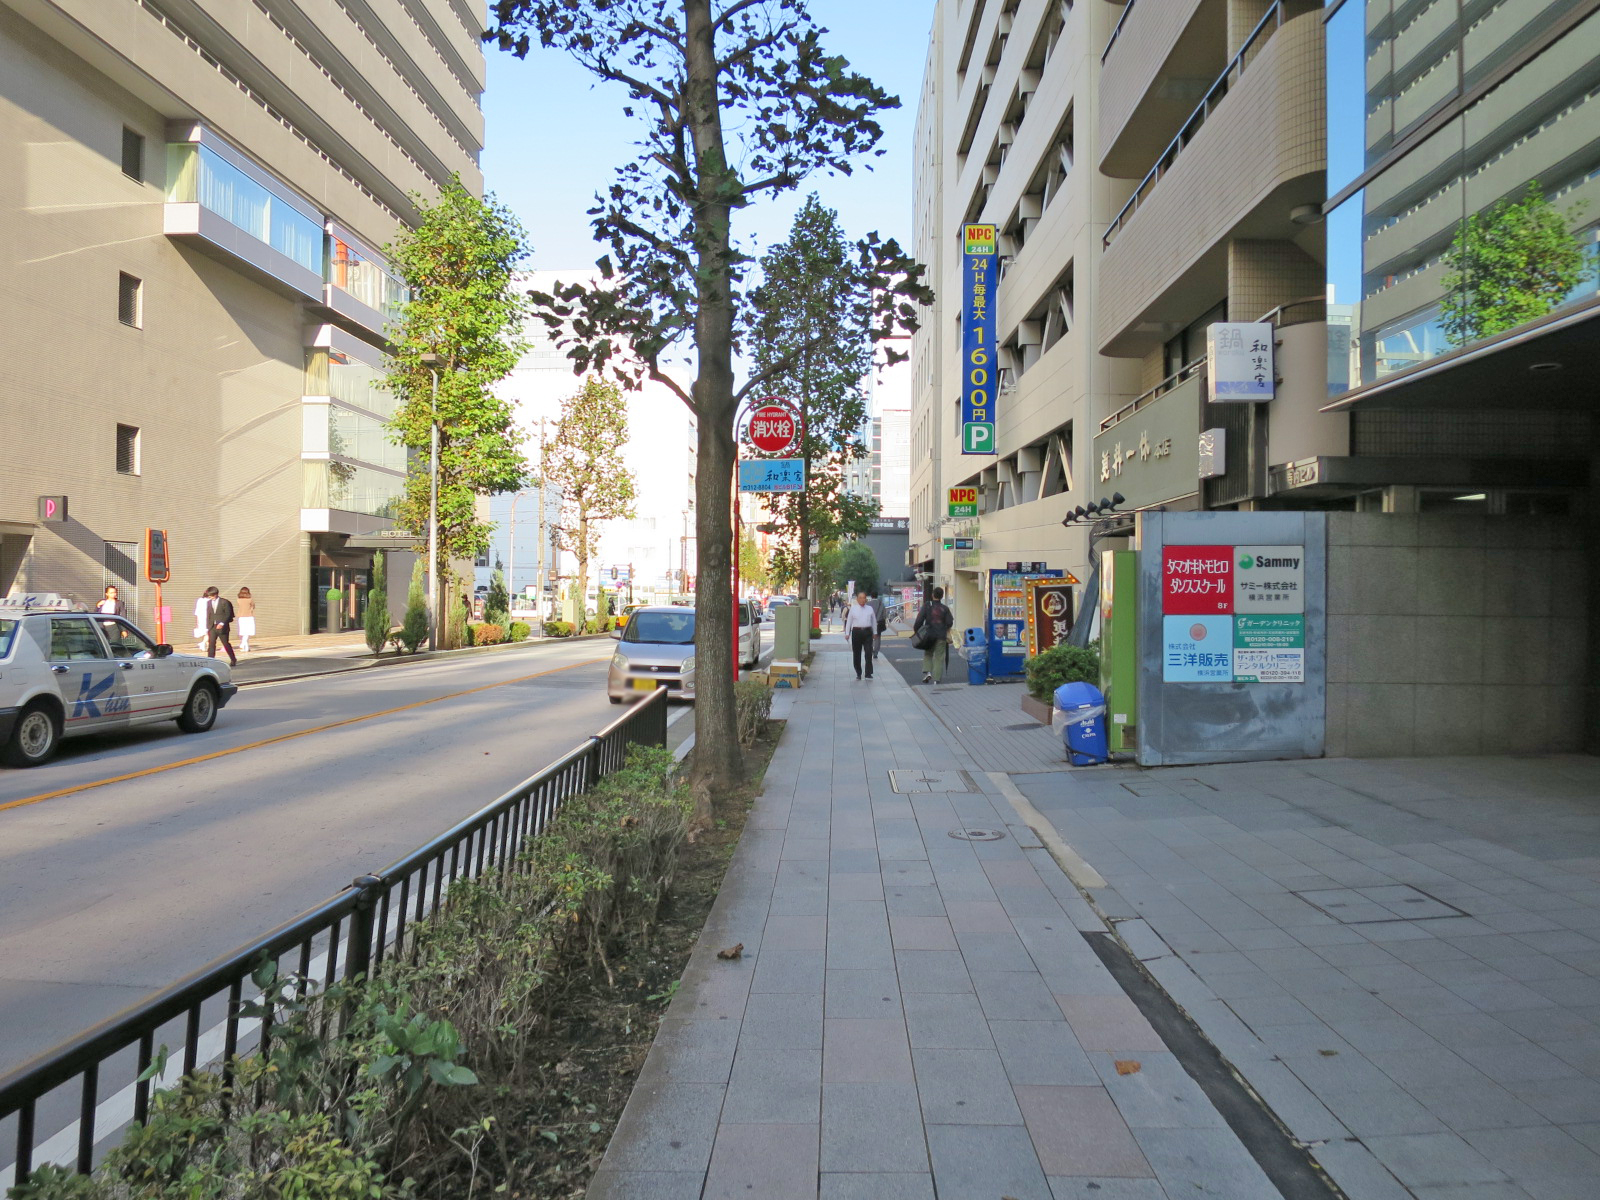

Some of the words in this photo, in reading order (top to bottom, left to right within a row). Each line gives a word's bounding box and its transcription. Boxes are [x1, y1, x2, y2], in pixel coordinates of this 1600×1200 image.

[968, 228, 992, 240] NPC
[1219, 328, 1243, 349] 鍋
[1250, 339, 1268, 388] 和楽宮
[753, 420, 791, 438] 消火栓
[971, 426, 989, 449] P
[950, 488, 976, 502] NPC
[1167, 559, 1229, 574] タマオキトモヒロ
[1256, 555, 1300, 570] Sammy
[1170, 578, 1226, 593] ダンススクール
[1240, 582, 1298, 590] サミー株式会社
[1168, 653, 1229, 667] 三洋販売
